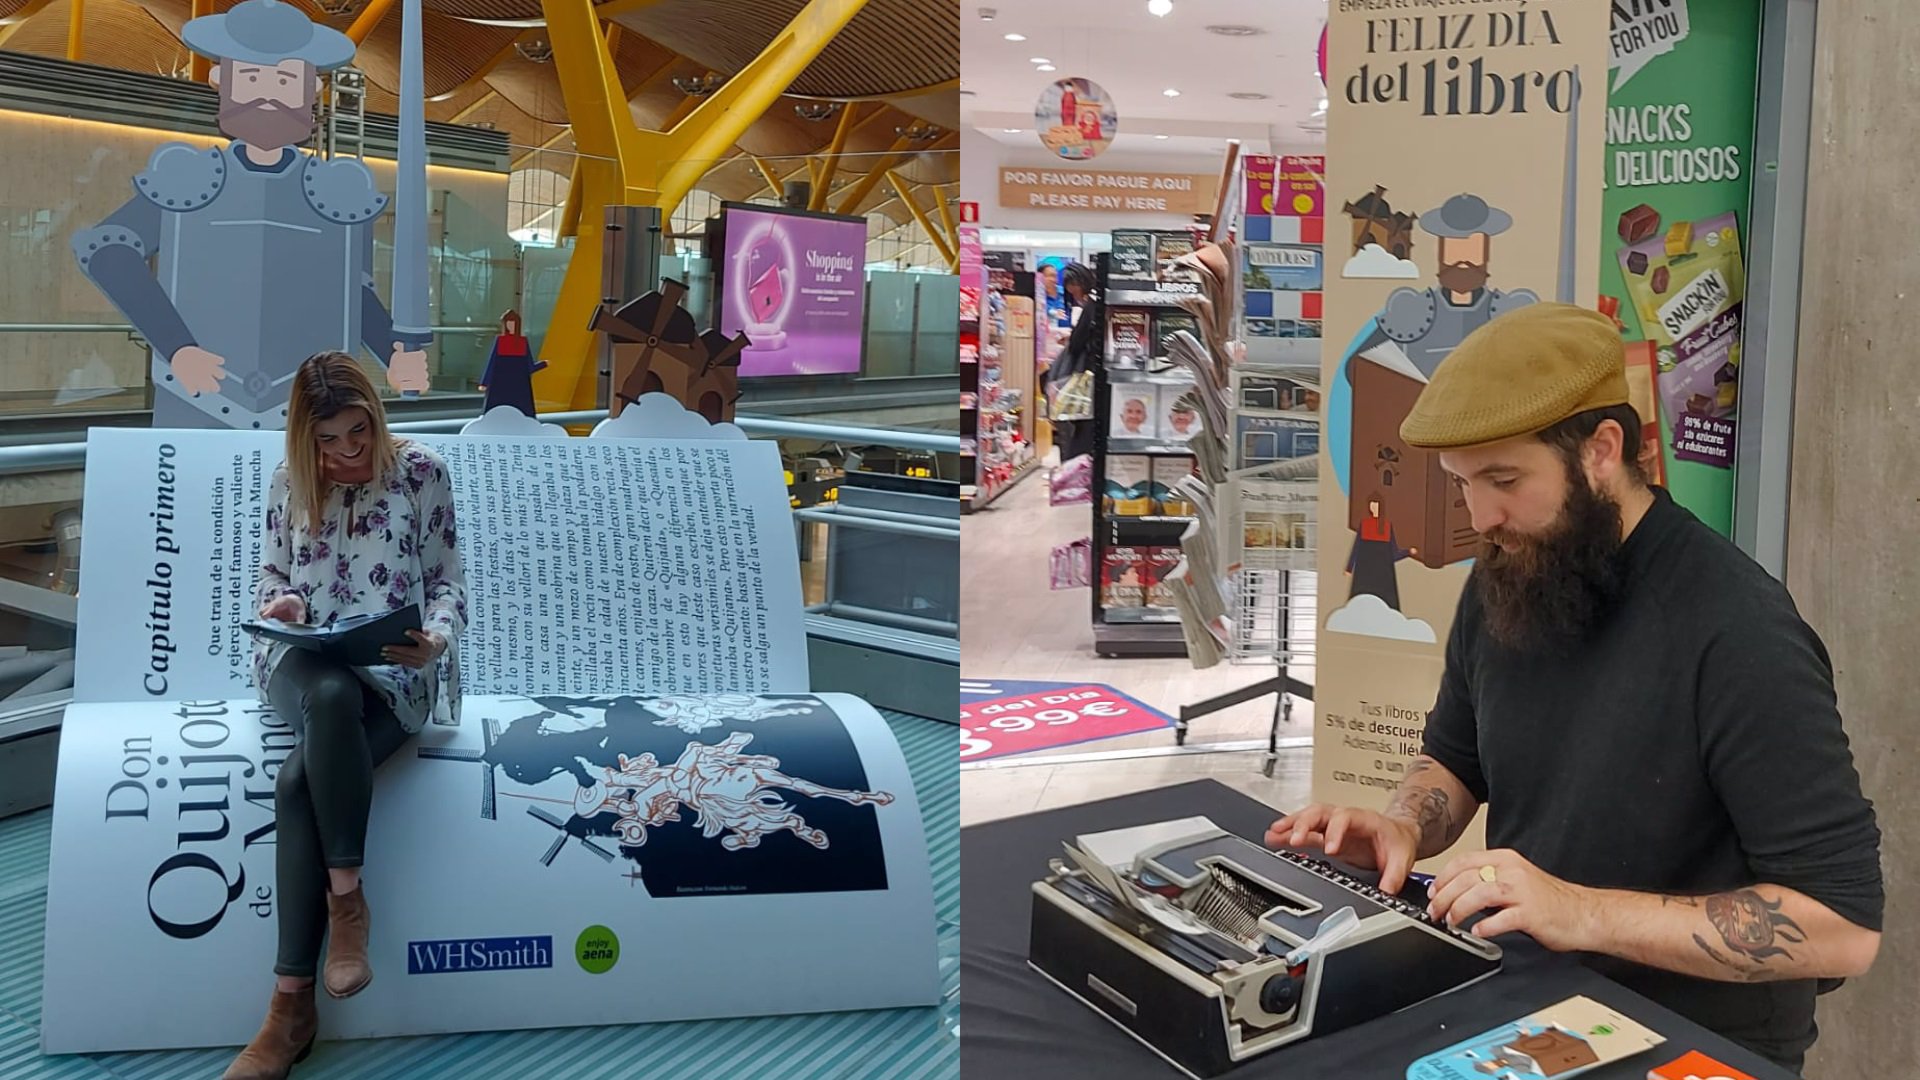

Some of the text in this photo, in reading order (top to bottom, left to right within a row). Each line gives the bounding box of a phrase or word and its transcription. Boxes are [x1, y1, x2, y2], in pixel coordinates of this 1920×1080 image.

[1367, 14, 1475, 53] FELIZ
[1487, 1, 1562, 47] DÍA
[1610, 26, 1646, 58] FOR
[1643, 12, 1680, 43] YOU
[1346, 56, 1582, 116] del libro
[1606, 104, 1692, 144] NACKS
[1004, 171, 1037, 185] POR
[1041, 173, 1094, 187] FAVOR
[1097, 175, 1149, 189] PAGUE
[1615, 145, 1740, 186] DELICIOSOS
[1029, 193, 1167, 210] PLEASE PAY HERE
[805, 249, 854, 274] Shopping
[466, 444, 478, 475] calzas
[480, 444, 496, 493] pantuflos
[511, 444, 523, 473] Tenía
[632, 457, 645, 483] tenía
[709, 456, 721, 479] poco
[249, 450, 262, 503] Mancha
[514, 477, 528, 501] fino.
[616, 446, 636, 511] madrugador
[722, 465, 739, 517] narración
[468, 477, 482, 516] velarte,
[487, 495, 495, 514] sus
[497, 459, 511, 527] entresemana
[639, 484, 650, 504] que
[710, 480, 728, 523] importa
[249, 506, 262, 518] la
[516, 504, 527, 527] más
[627, 513, 639, 540] gran
[639, 506, 651, 533] decir
[744, 505, 759, 545] verdad.
[248, 522, 261, 538] de
[474, 532, 485, 559] sayo
[716, 525, 728, 546] esto
[144, 443, 180, 696] Capítulo primero
[208, 477, 224, 656] Que trata de la condición
[227, 454, 245, 680] y ejercicio del famoso y valiente
[487, 538, 501, 579] fiestas,
[503, 549, 514, 575] días
[627, 543, 641, 579] rostro,
[642, 535, 658, 582] Quieren
[719, 547, 731, 572] Pero
[737, 547, 748, 569] que
[473, 560, 484, 618] concluían
[489, 583, 499, 599] las
[505, 580, 515, 596] los
[520, 560, 531, 599] vellorí
[737, 572, 749, 603] basta
[752, 576, 768, 612] punto
[632, 597, 646, 635] enjuto
[649, 585, 657, 616] caza.
[493, 603, 503, 632] para
[525, 620, 533, 641] con
[740, 606, 752, 649] cuento:
[475, 621, 485, 651] della
[509, 615, 519, 662] mesmo,
[757, 632, 771, 665] salga
[475, 652, 485, 682] resto
[491, 636, 501, 680] velludo
[637, 638, 646, 680] carnes,
[649, 649, 662, 687] amigo
[727, 645, 738, 694] lamaba
[981, 699, 1037, 715] del
[1041, 691, 1101, 705] Día
[1385, 704, 1420, 721] libros
[1325, 713, 1424, 739] 5% de descuen
[1399, 741, 1421, 757] llév
[105, 736, 152, 823] Don
[1332, 770, 1404, 792] con compr
[1374, 759, 1404, 773] o un
[147, 700, 255, 939] Quijote
[242, 701, 296, 918] de Manch
[411, 939, 550, 972] WHSmith
[582, 949, 613, 960] aena
[586, 939, 609, 951] enjoy
